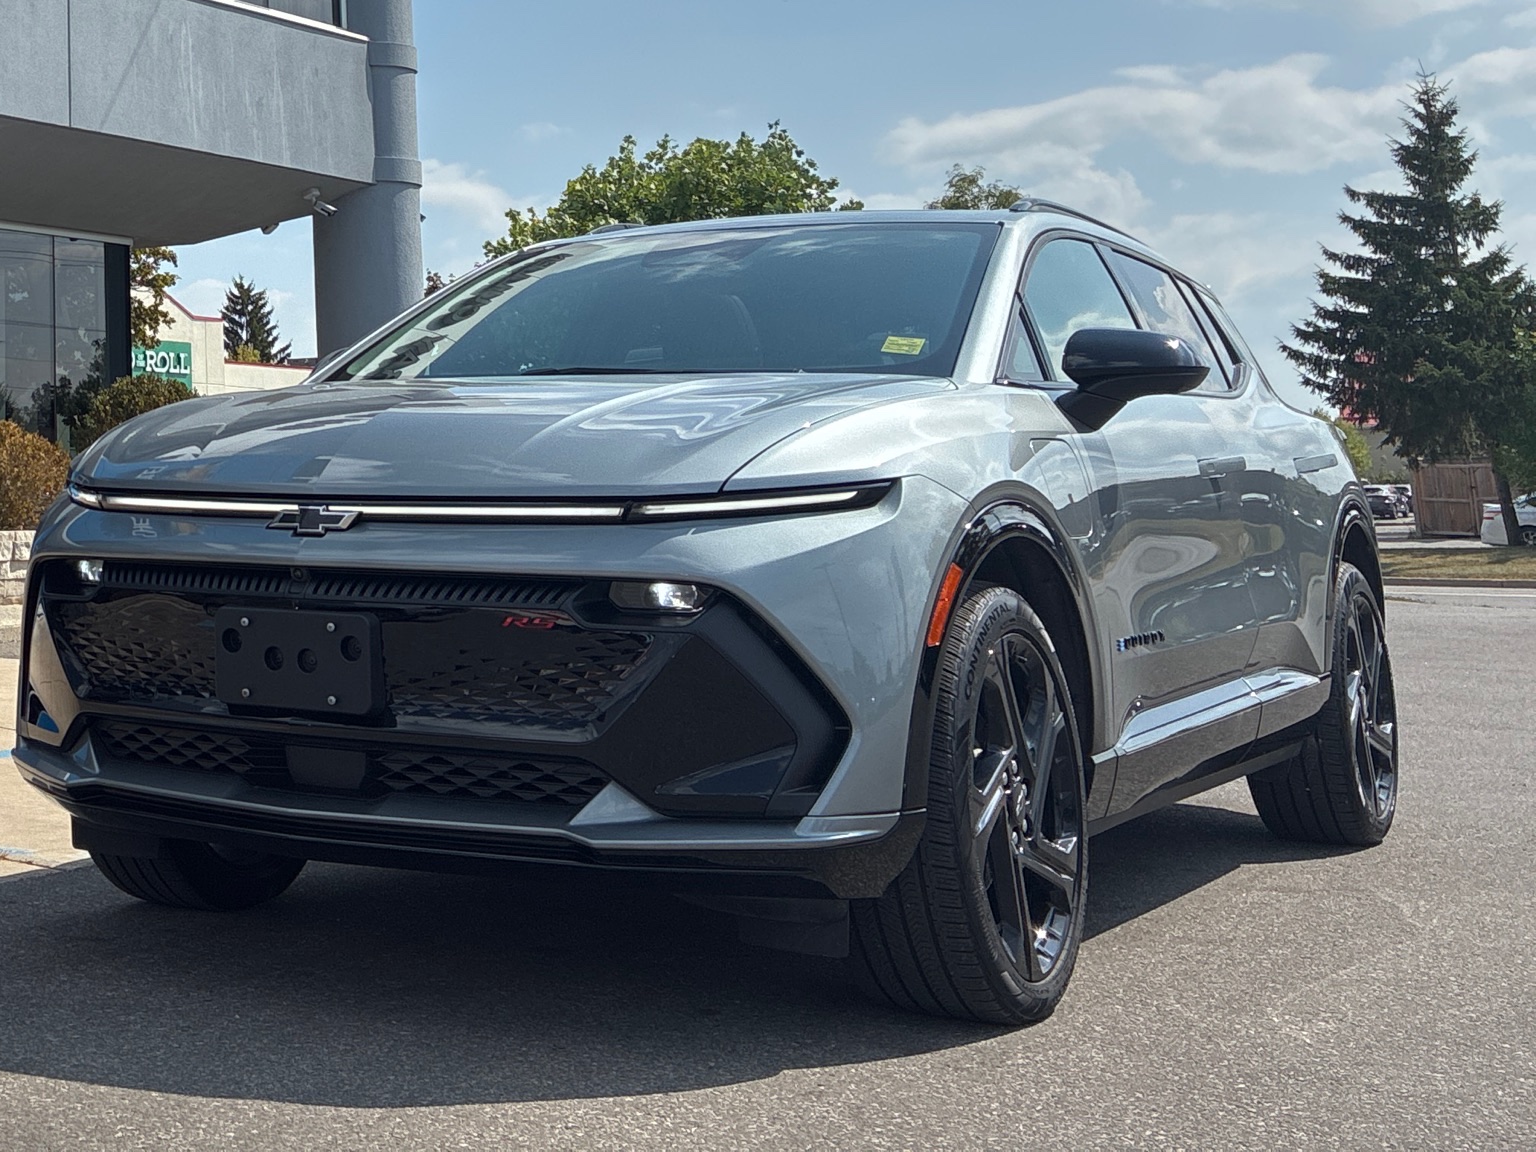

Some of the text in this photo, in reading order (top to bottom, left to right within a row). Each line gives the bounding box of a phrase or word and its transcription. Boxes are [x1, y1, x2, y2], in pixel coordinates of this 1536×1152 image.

[145, 350, 190, 374] ROLL
[501, 615, 556, 630] RS
[964, 602, 1012, 700] CONTINENTAL
